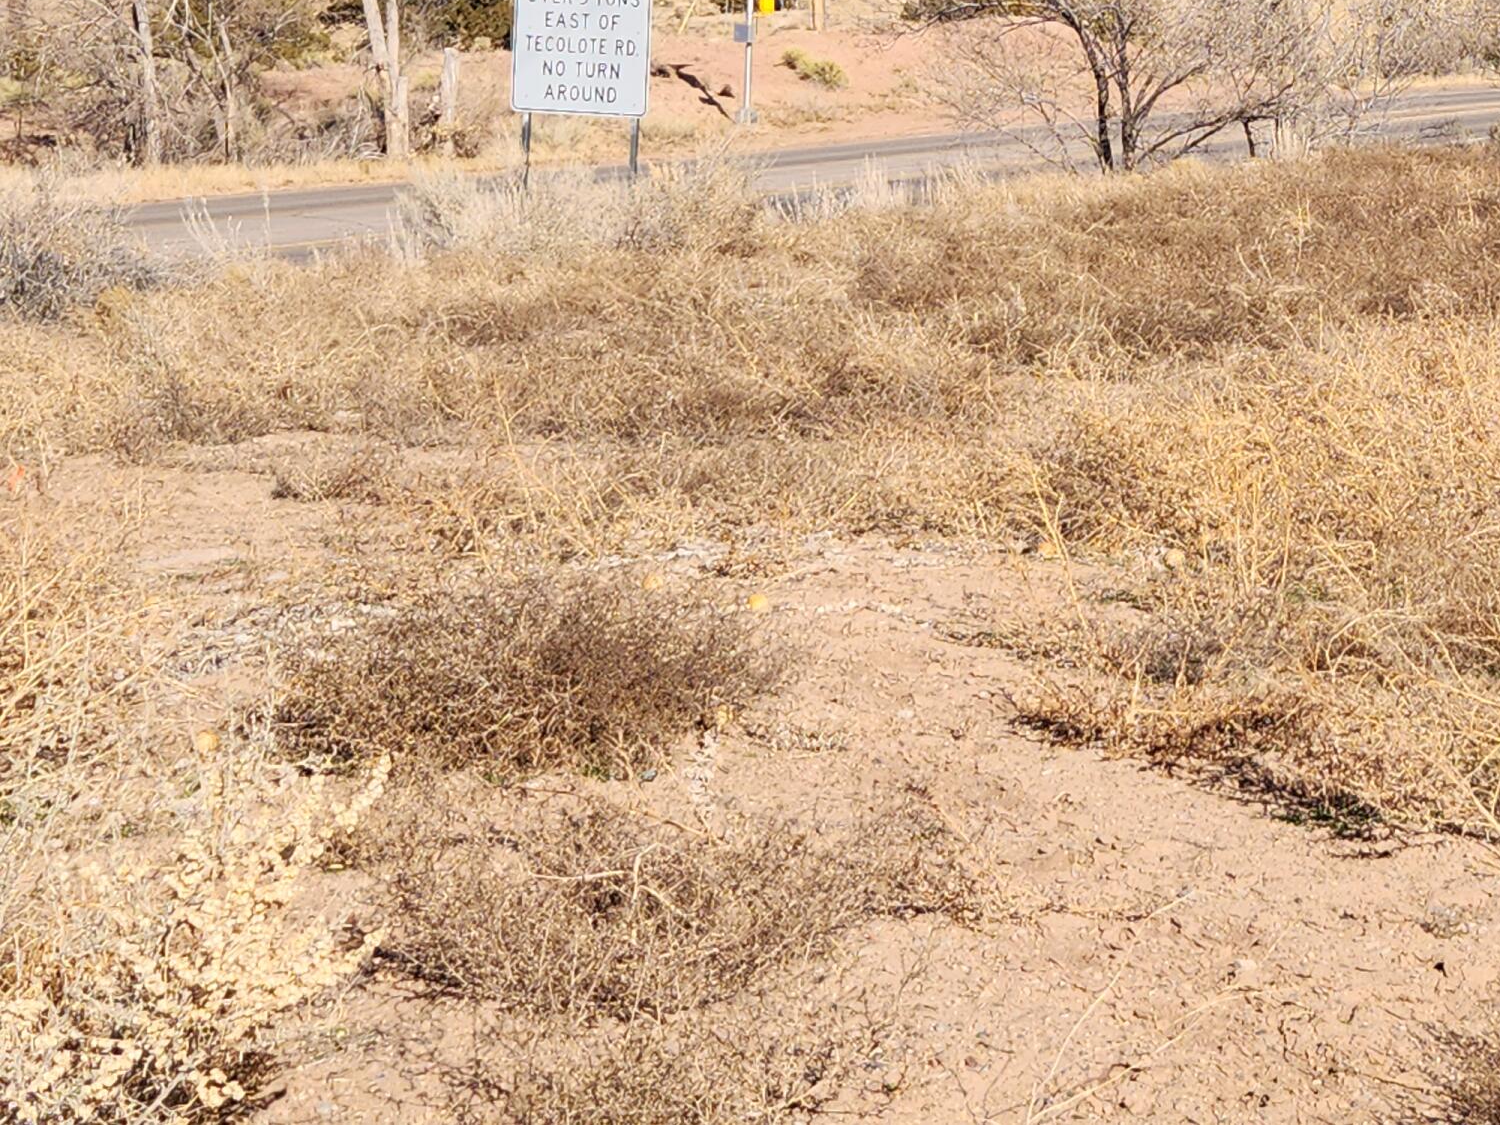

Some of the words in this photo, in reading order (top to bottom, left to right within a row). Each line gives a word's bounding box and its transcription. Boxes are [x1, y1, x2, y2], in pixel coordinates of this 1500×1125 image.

[545, 11, 591, 29] EAST
[599, 14, 621, 31] OF
[526, 35, 606, 55] TECOLOTE
[615, 38, 640, 57] RD.
[542, 60, 566, 77] NO
[575, 61, 621, 80] TURN
[544, 84, 617, 104] AROUND
